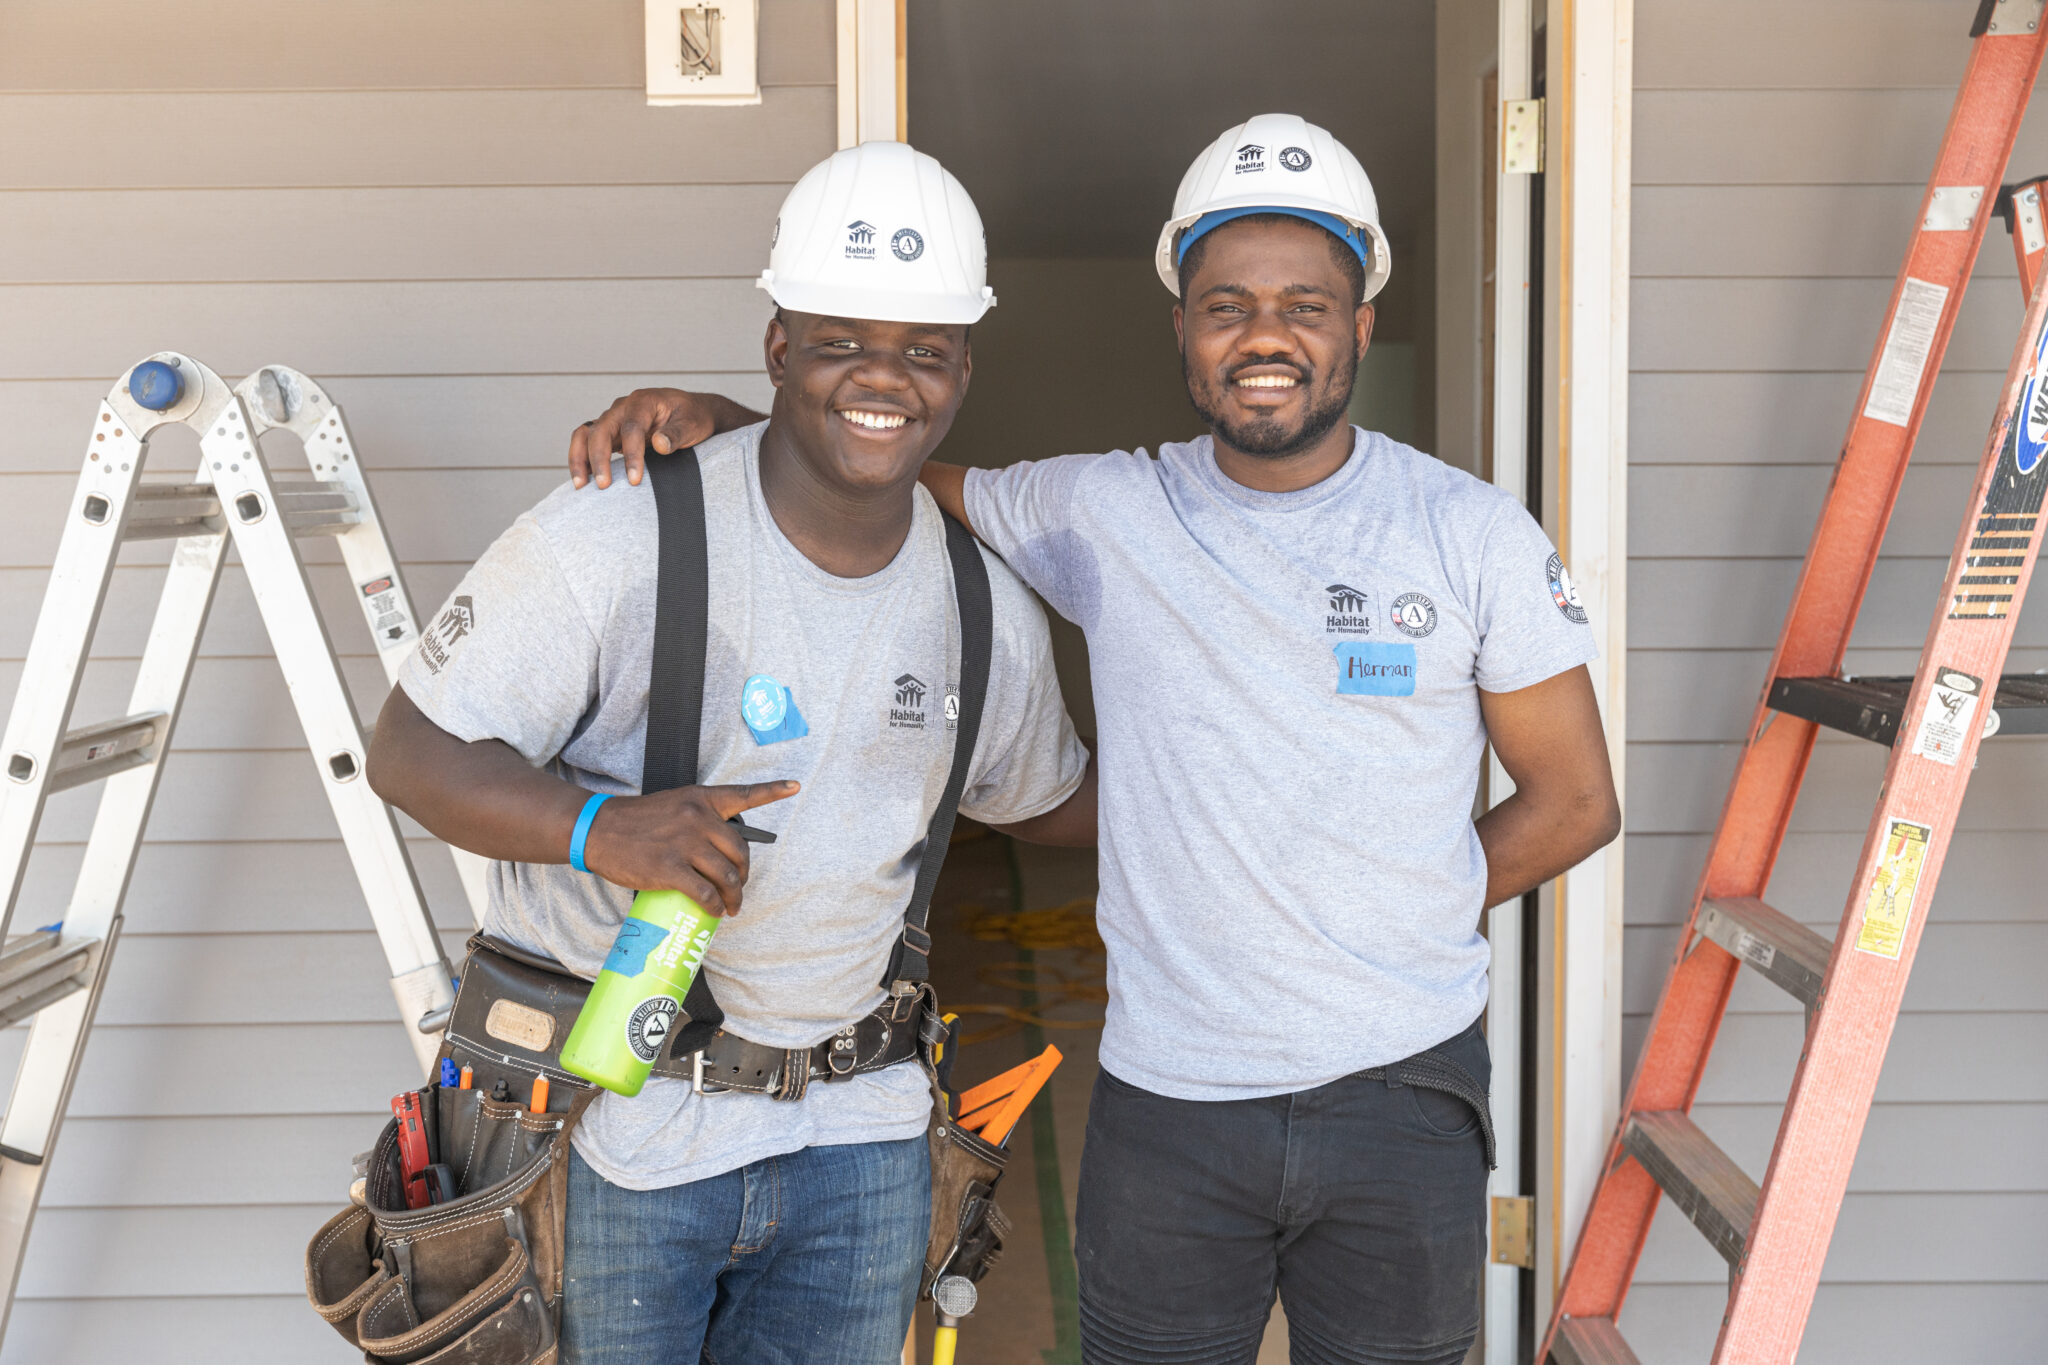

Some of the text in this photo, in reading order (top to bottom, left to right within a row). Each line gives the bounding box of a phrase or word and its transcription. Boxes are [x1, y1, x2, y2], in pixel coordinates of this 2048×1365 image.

[1235, 161, 1265, 171] Habitat
[845, 246, 875, 255] Habitat
[1326, 616, 1370, 627] Habitat
[1337, 627, 1370, 635] Humanity
[1348, 656, 1412, 678] Herman
[889, 708, 926, 723] Habitat
[889, 720, 925, 730] for Humanity
[663, 913, 700, 969] Habitat
